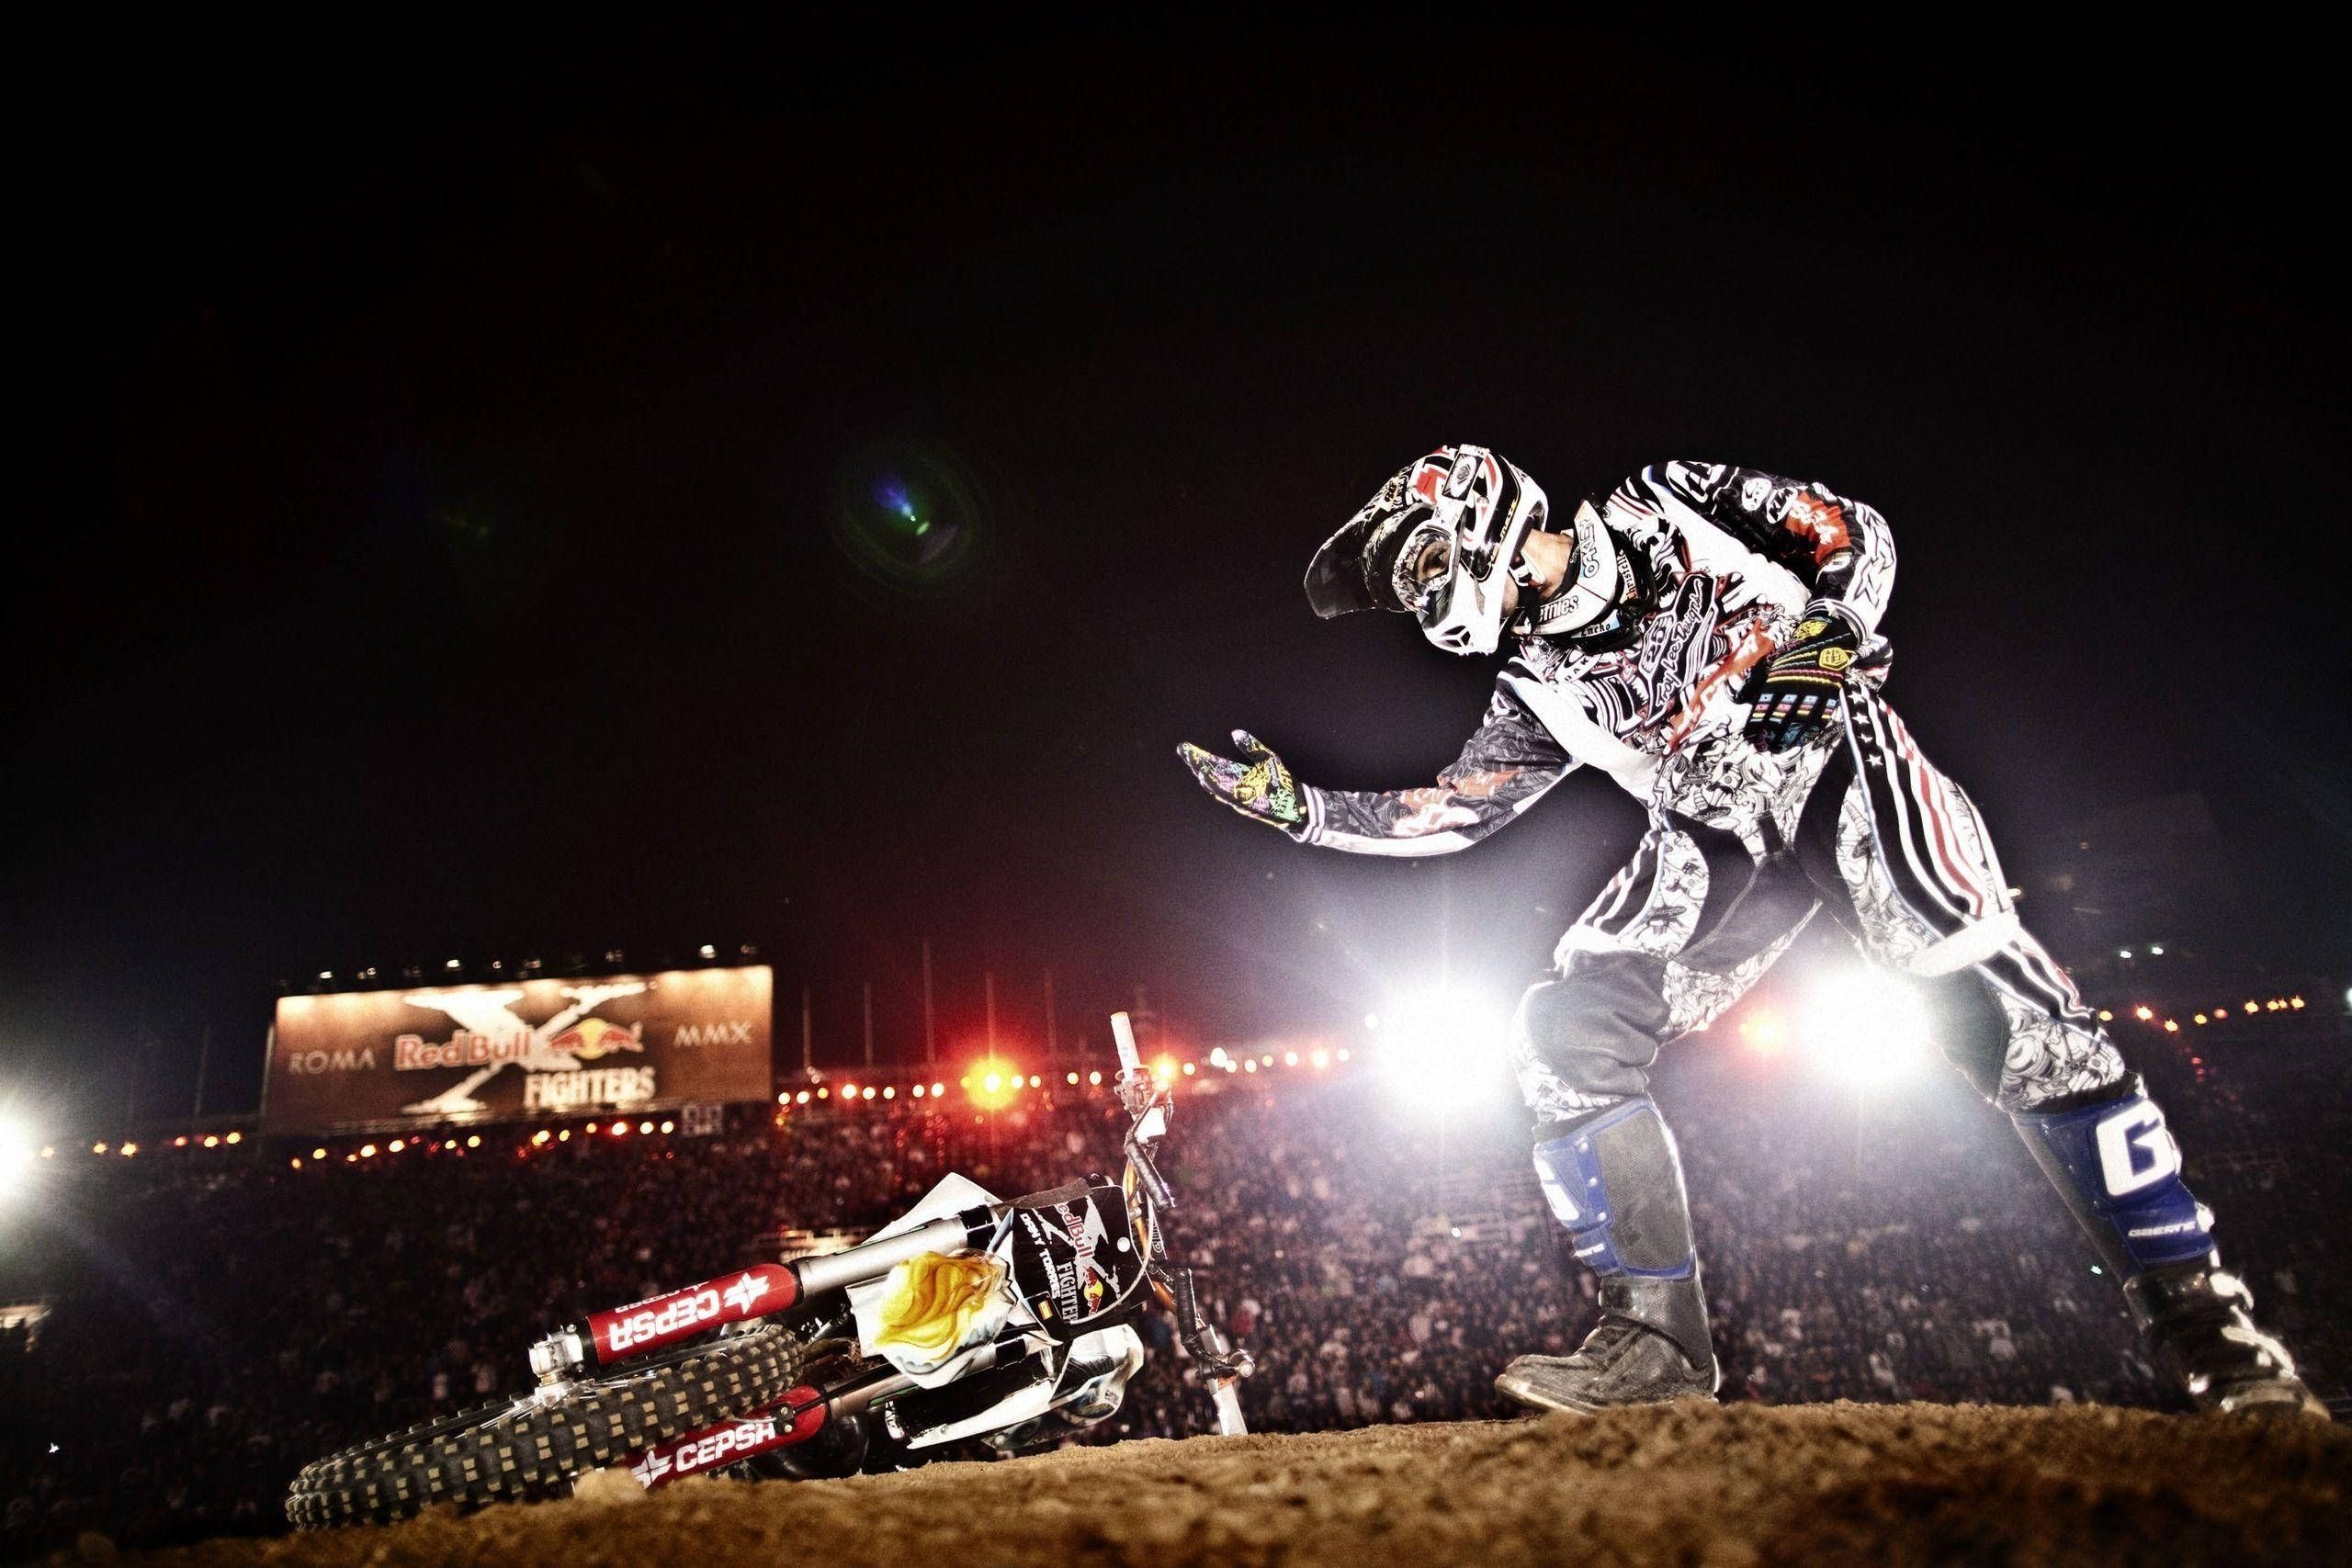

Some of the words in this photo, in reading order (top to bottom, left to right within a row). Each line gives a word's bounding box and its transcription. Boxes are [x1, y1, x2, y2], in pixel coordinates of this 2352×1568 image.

[1769, 490, 1793, 520] KTM
[1579, 518, 1600, 578] OAKLEY
[1674, 579, 1703, 640] Designs
[1565, 657, 1589, 682] OAK
[1661, 637, 1682, 672] Lee
[1656, 672, 1681, 706] Troy
[394, 1031, 461, 1071] Red
[465, 1029, 532, 1066] Bull
[673, 1021, 752, 1047] MMX
[288, 1048, 375, 1074] ROMA
[525, 1066, 656, 1108] FIGHTERS
[2097, 1100, 2177, 1196] G
[1055, 1201, 1080, 1229] ed
[1069, 1222, 1094, 1258] Bull
[1020, 1213, 1046, 1246] DANY
[1038, 1248, 1061, 1299] TORRES
[1057, 1261, 1080, 1325] FIGHTER
[609, 1289, 720, 1351] CEPSA
[676, 1423, 776, 1472] CEPSA
